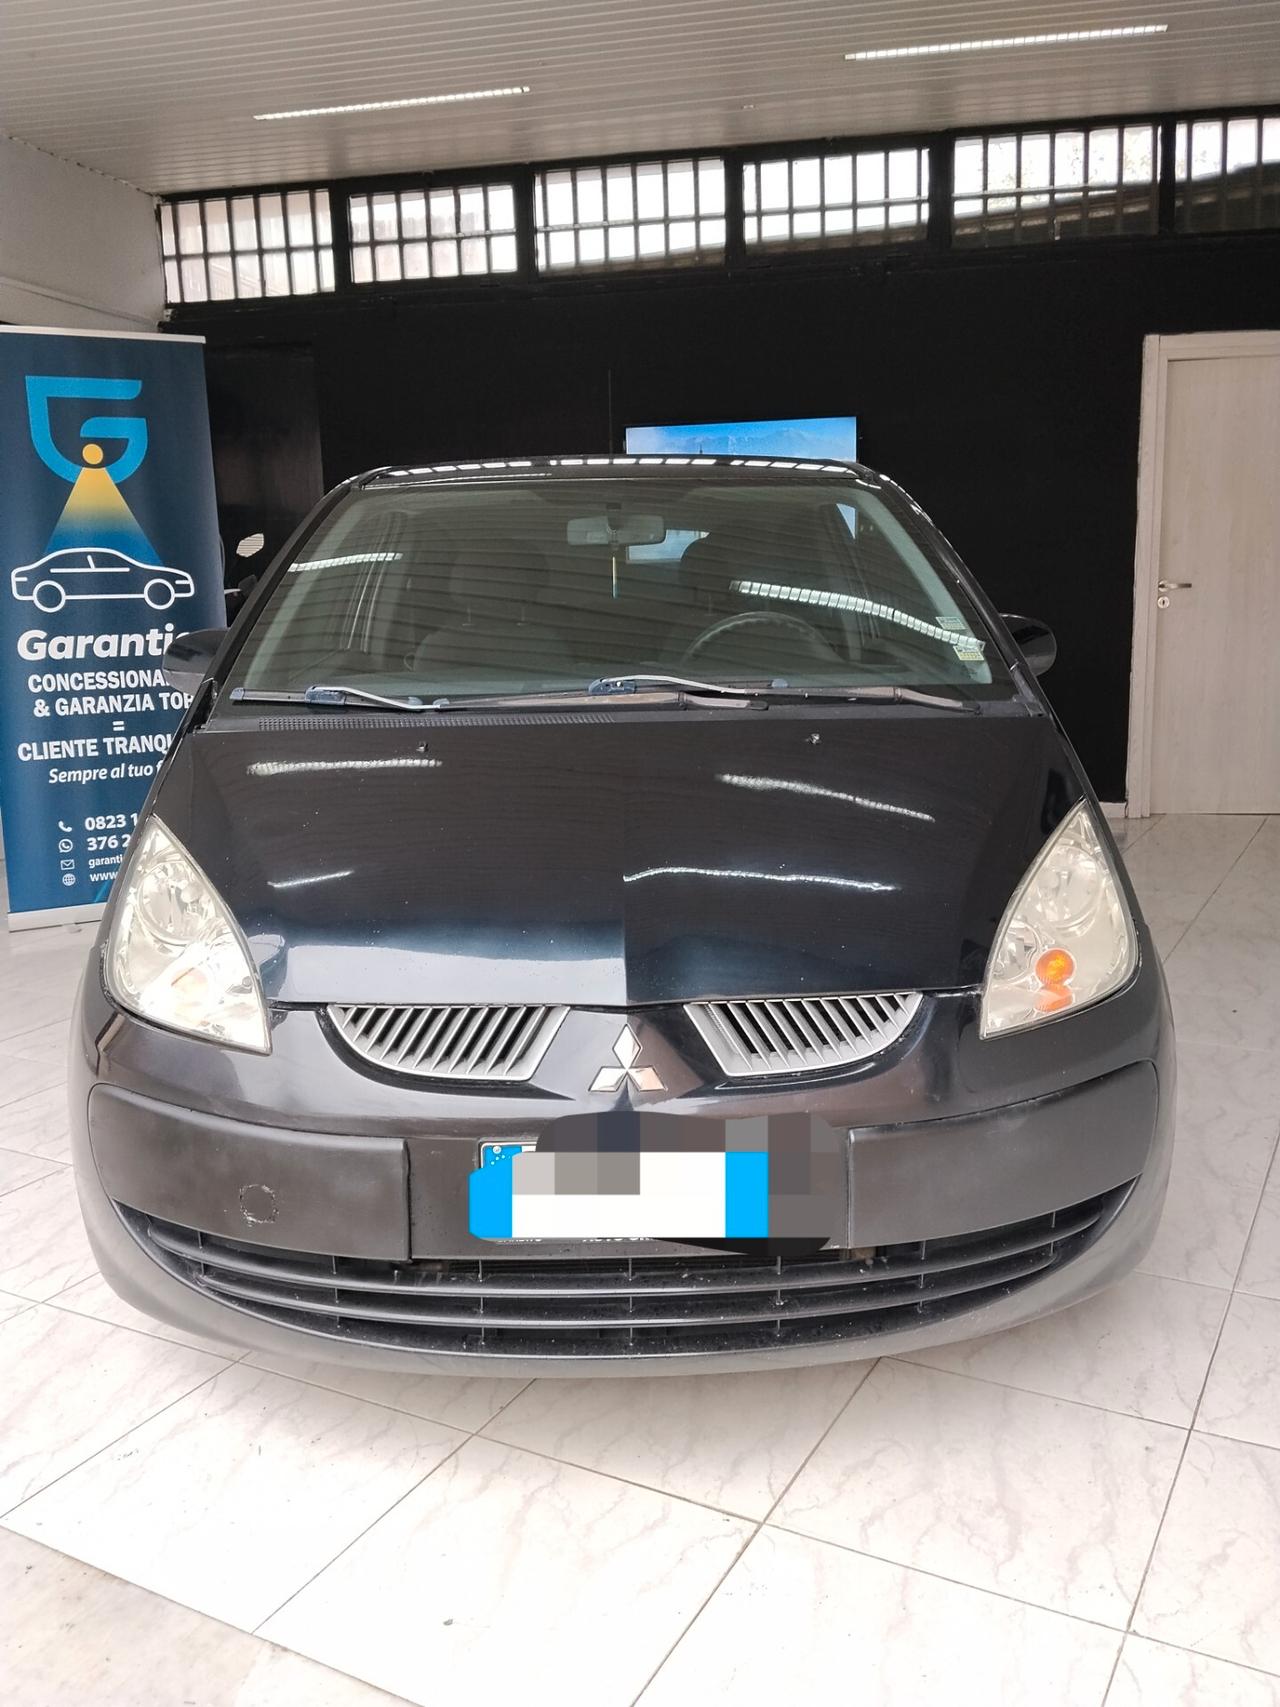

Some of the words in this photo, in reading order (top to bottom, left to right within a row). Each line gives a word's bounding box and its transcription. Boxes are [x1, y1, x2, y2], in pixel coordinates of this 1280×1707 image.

[17, 623, 190, 661] Garanti
[28, 669, 170, 693] CONCESSIONA
[33, 700, 50, 717] &
[55, 696, 154, 716] GARANZIA
[18, 739, 98, 761] CLIENTE
[49, 767, 107, 784] Sempre
[111, 763, 124, 779] al
[128, 764, 153, 778] tuo
[85, 814, 126, 830] 0823
[87, 835, 118, 851] 376
